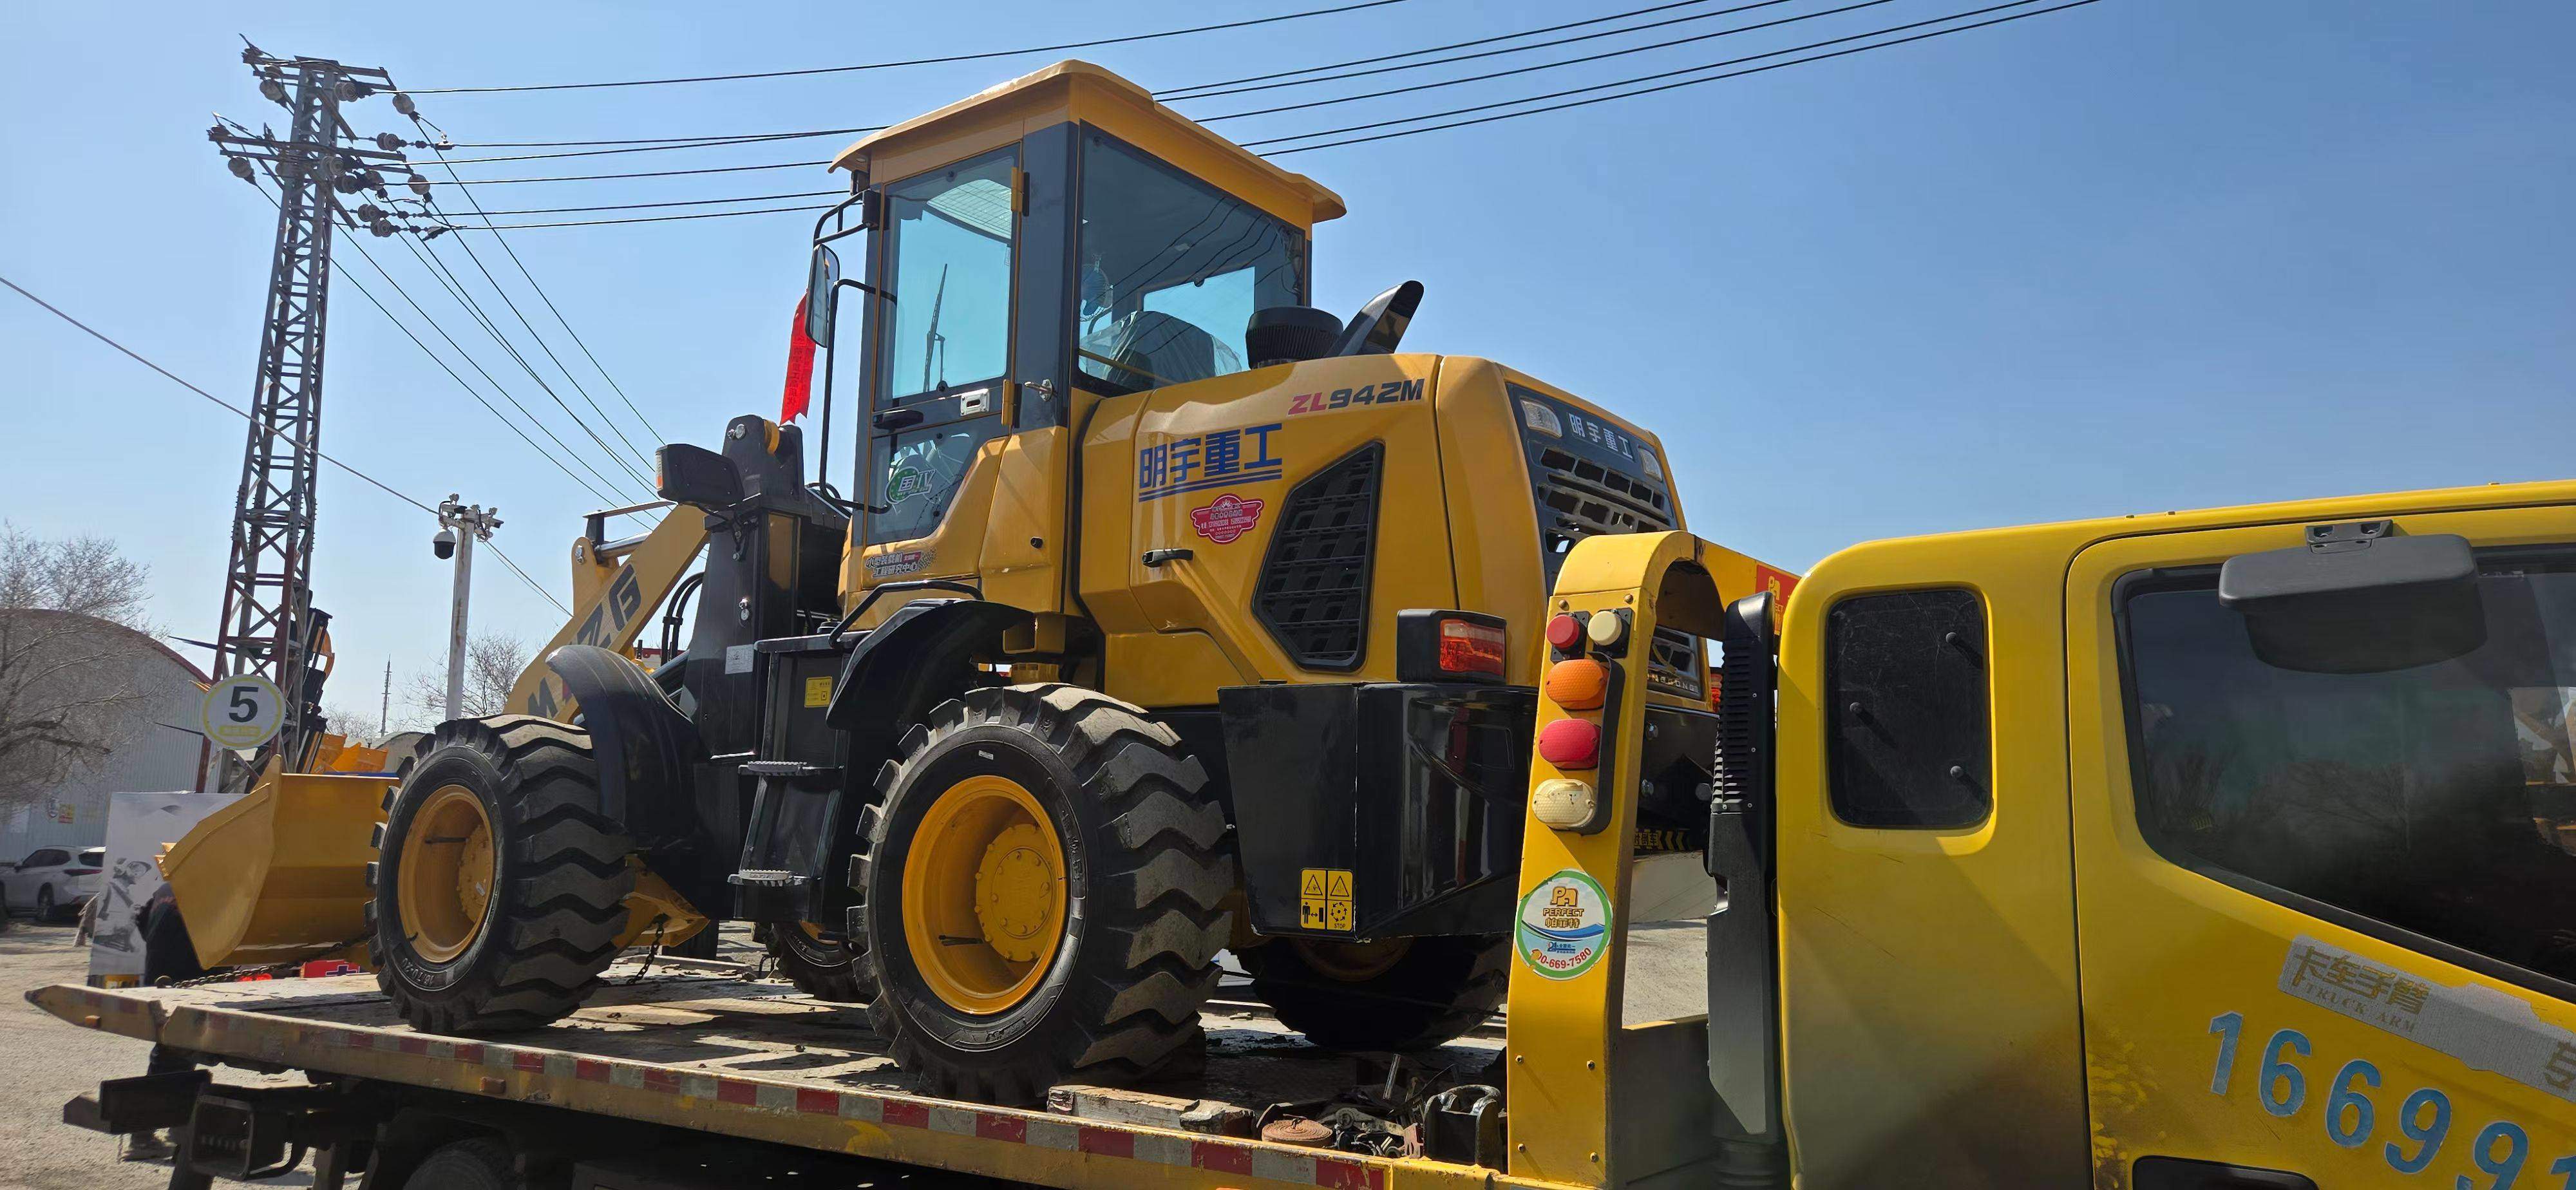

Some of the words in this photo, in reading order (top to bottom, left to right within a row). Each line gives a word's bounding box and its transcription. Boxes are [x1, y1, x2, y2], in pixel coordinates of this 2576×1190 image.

[1288, 379, 1425, 415] ZL942M
[1139, 422, 1282, 489] 明宇重工
[1568, 413, 1634, 459] 明宇重工
[527, 563, 641, 719] MZG
[229, 686, 259, 723] 5
[1543, 908, 1584, 916] PERFECT
[1545, 918, 1580, 929] 帕菲特
[2292, 946, 2432, 1015] 卡车手臂
[2305, 981, 2367, 1015] TRUCK
[2376, 1012, 2416, 1033] ARM
